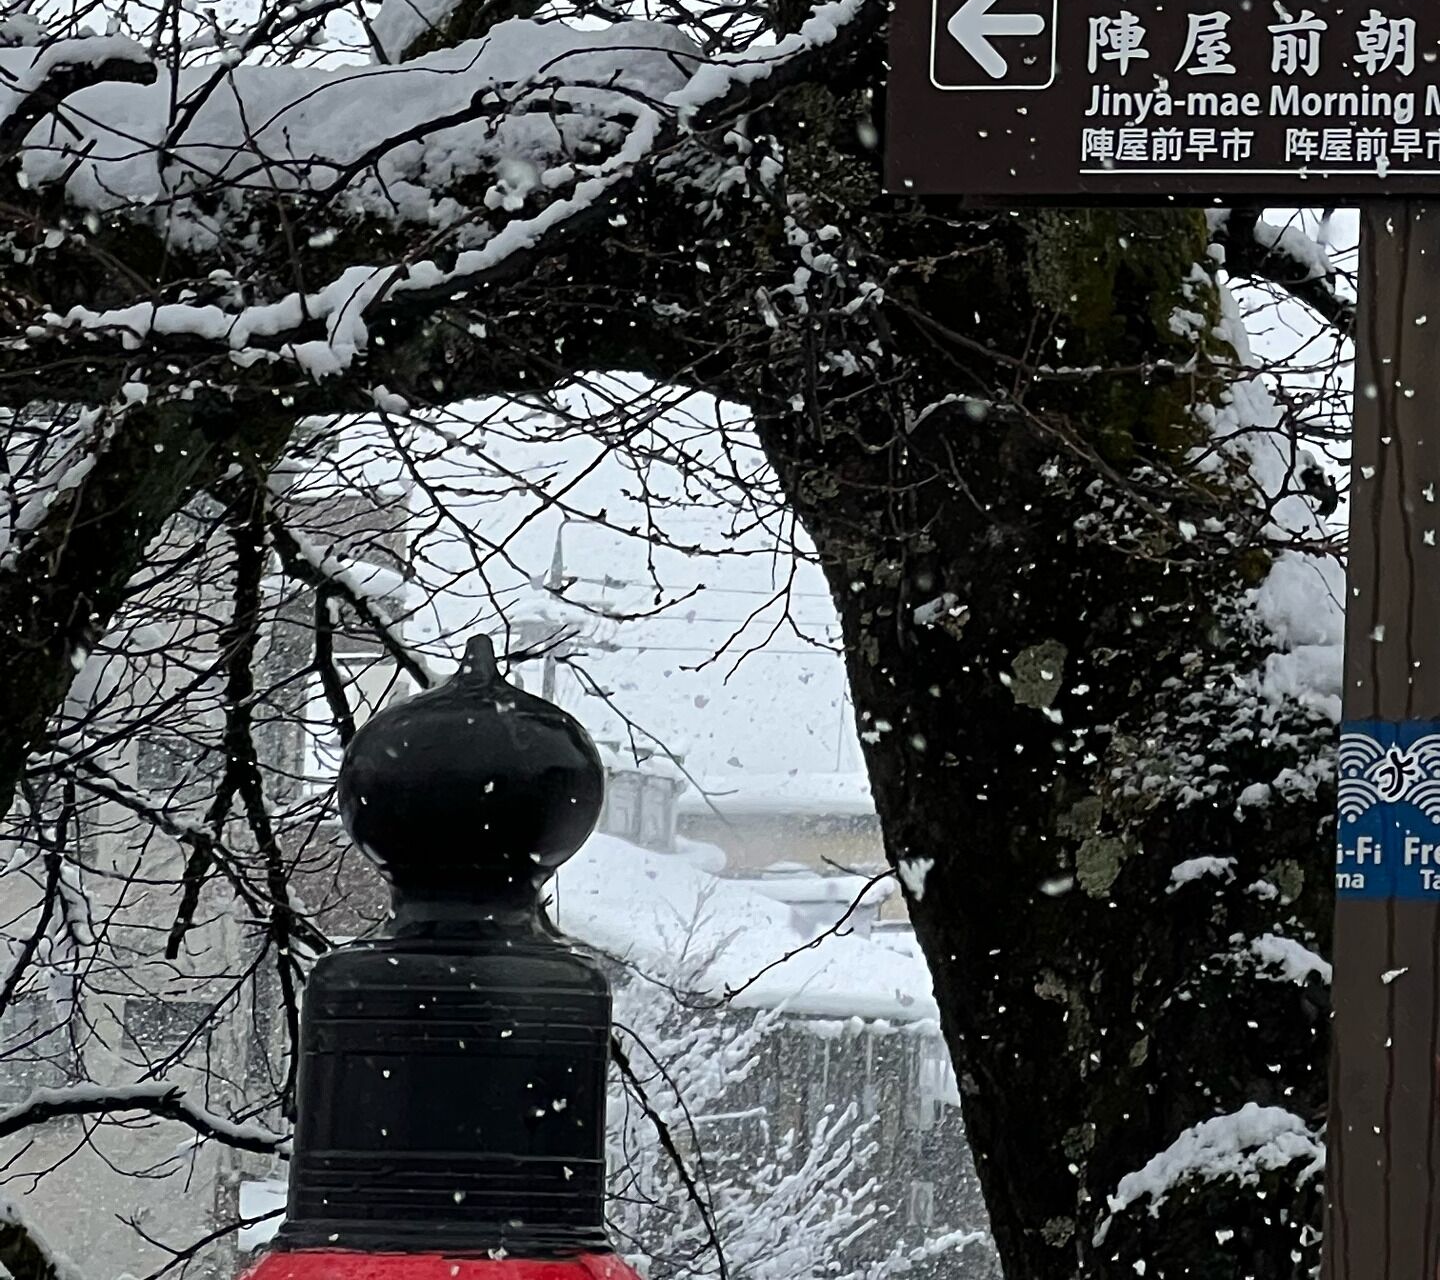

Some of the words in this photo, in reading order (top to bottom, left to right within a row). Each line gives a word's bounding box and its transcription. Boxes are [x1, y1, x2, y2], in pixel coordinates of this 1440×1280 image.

[1084, 86, 1260, 124] Jinya-mae
[1269, 86, 1414, 124] Morning
[1081, 128, 1254, 163] 陣屋前早市
